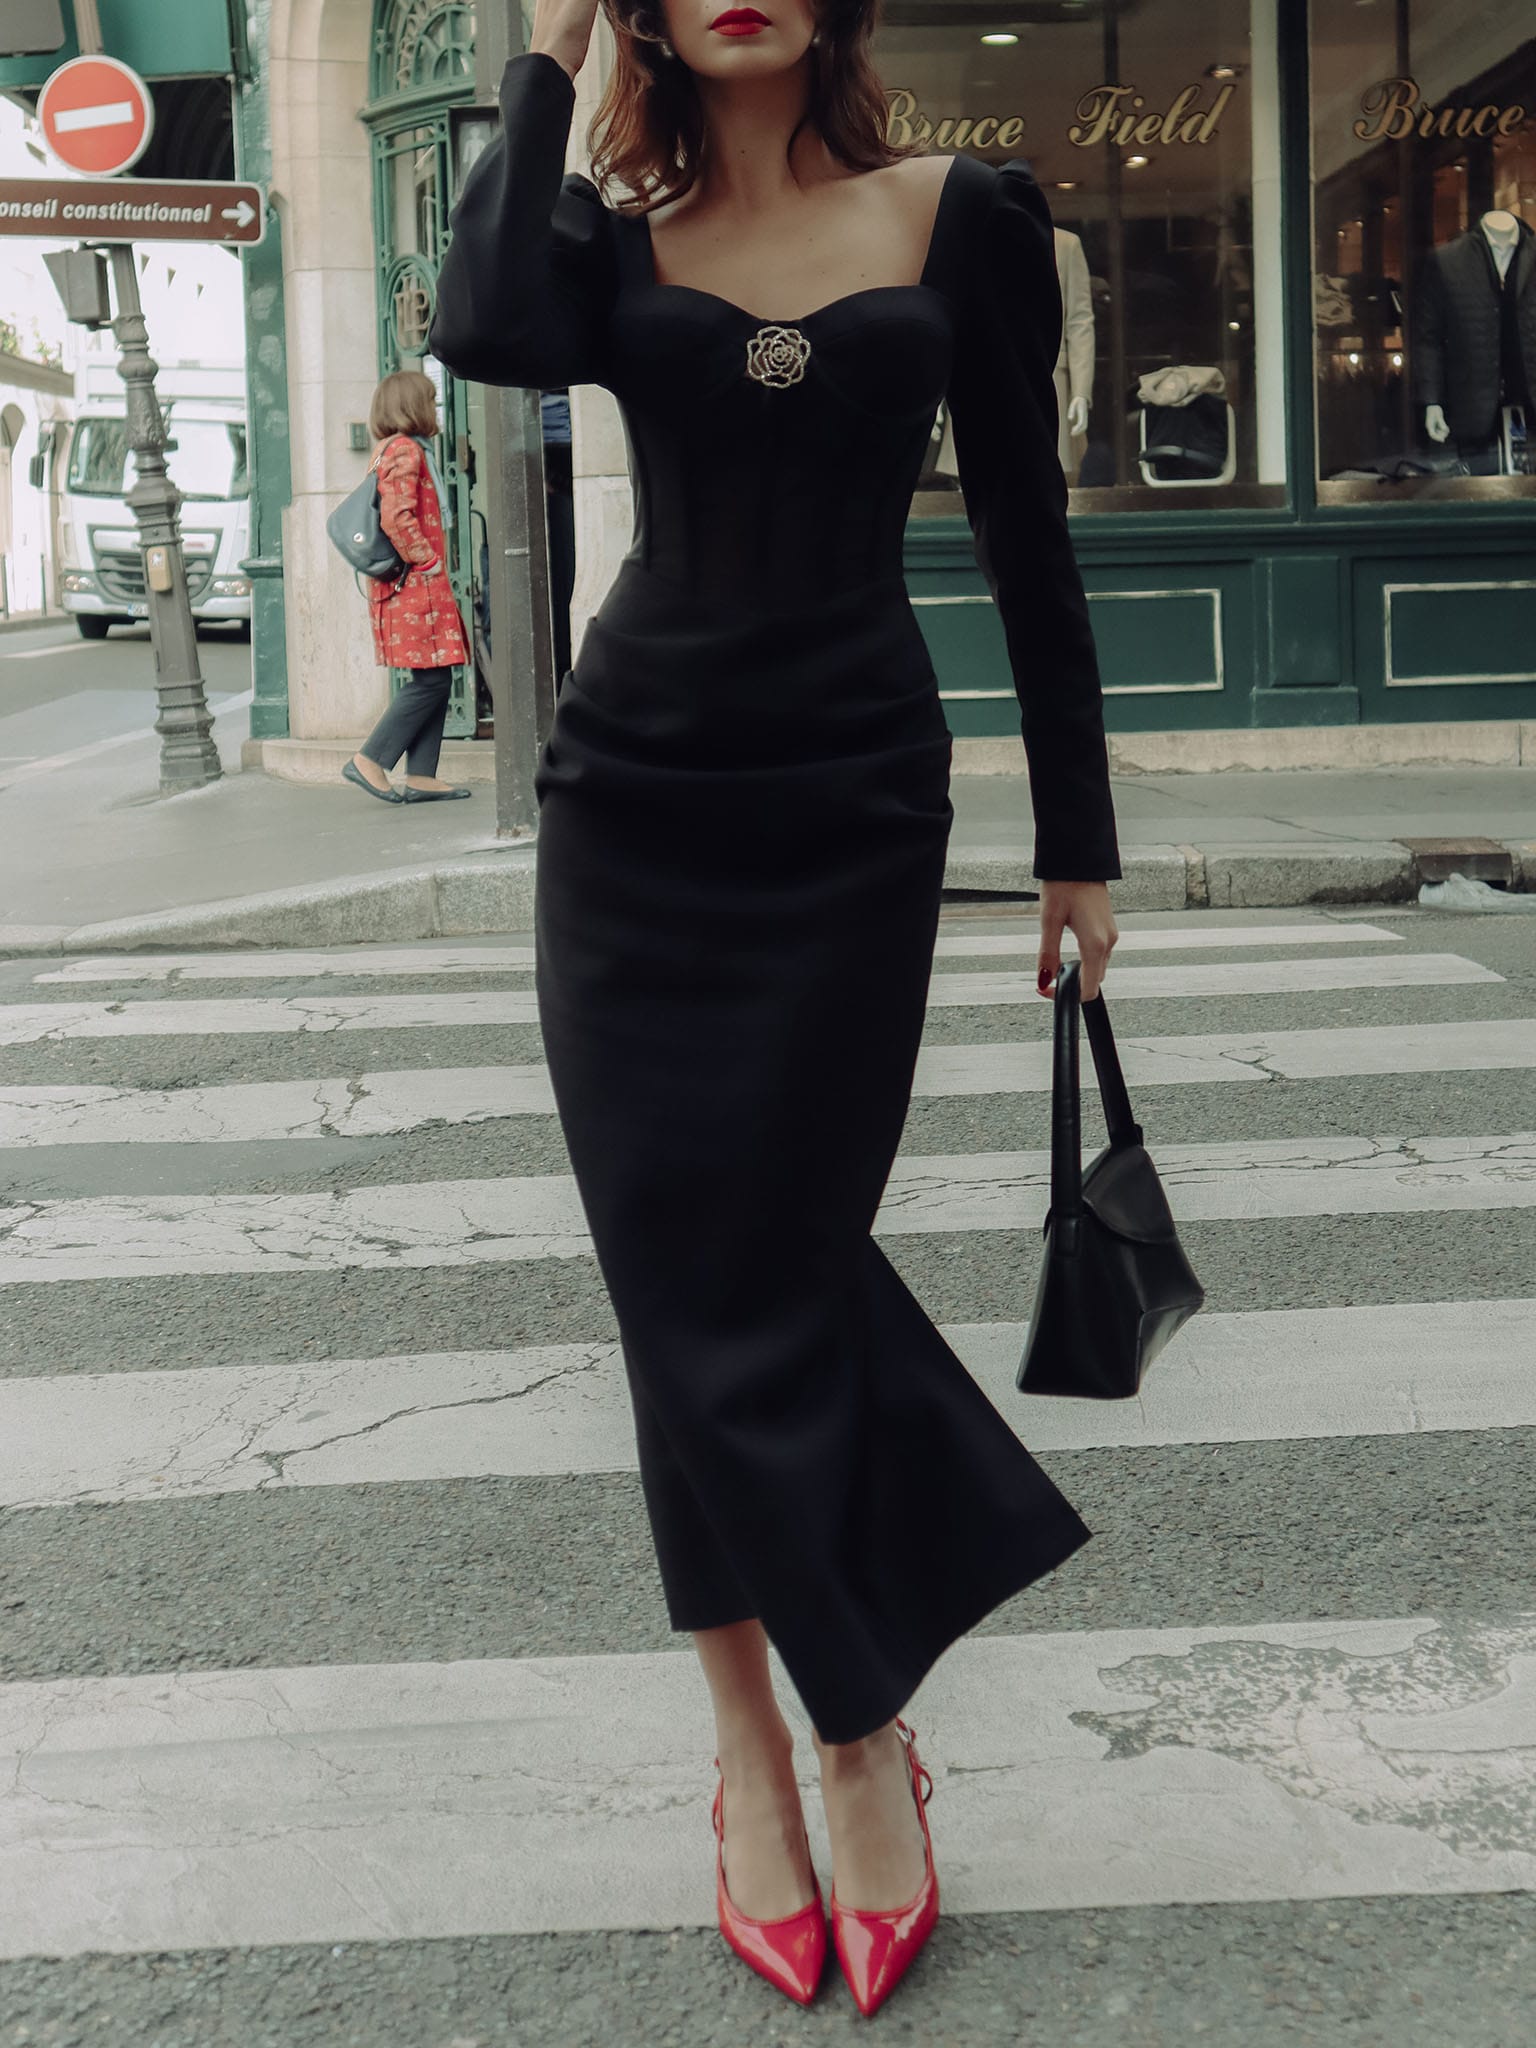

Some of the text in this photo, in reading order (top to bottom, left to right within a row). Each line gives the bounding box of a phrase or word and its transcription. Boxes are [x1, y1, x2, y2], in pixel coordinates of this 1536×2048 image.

[884, 83, 1238, 149] Bruce Field
[1353, 77, 1526, 140] Bruce
[0, 198, 213, 223] onseil constitutionnel
